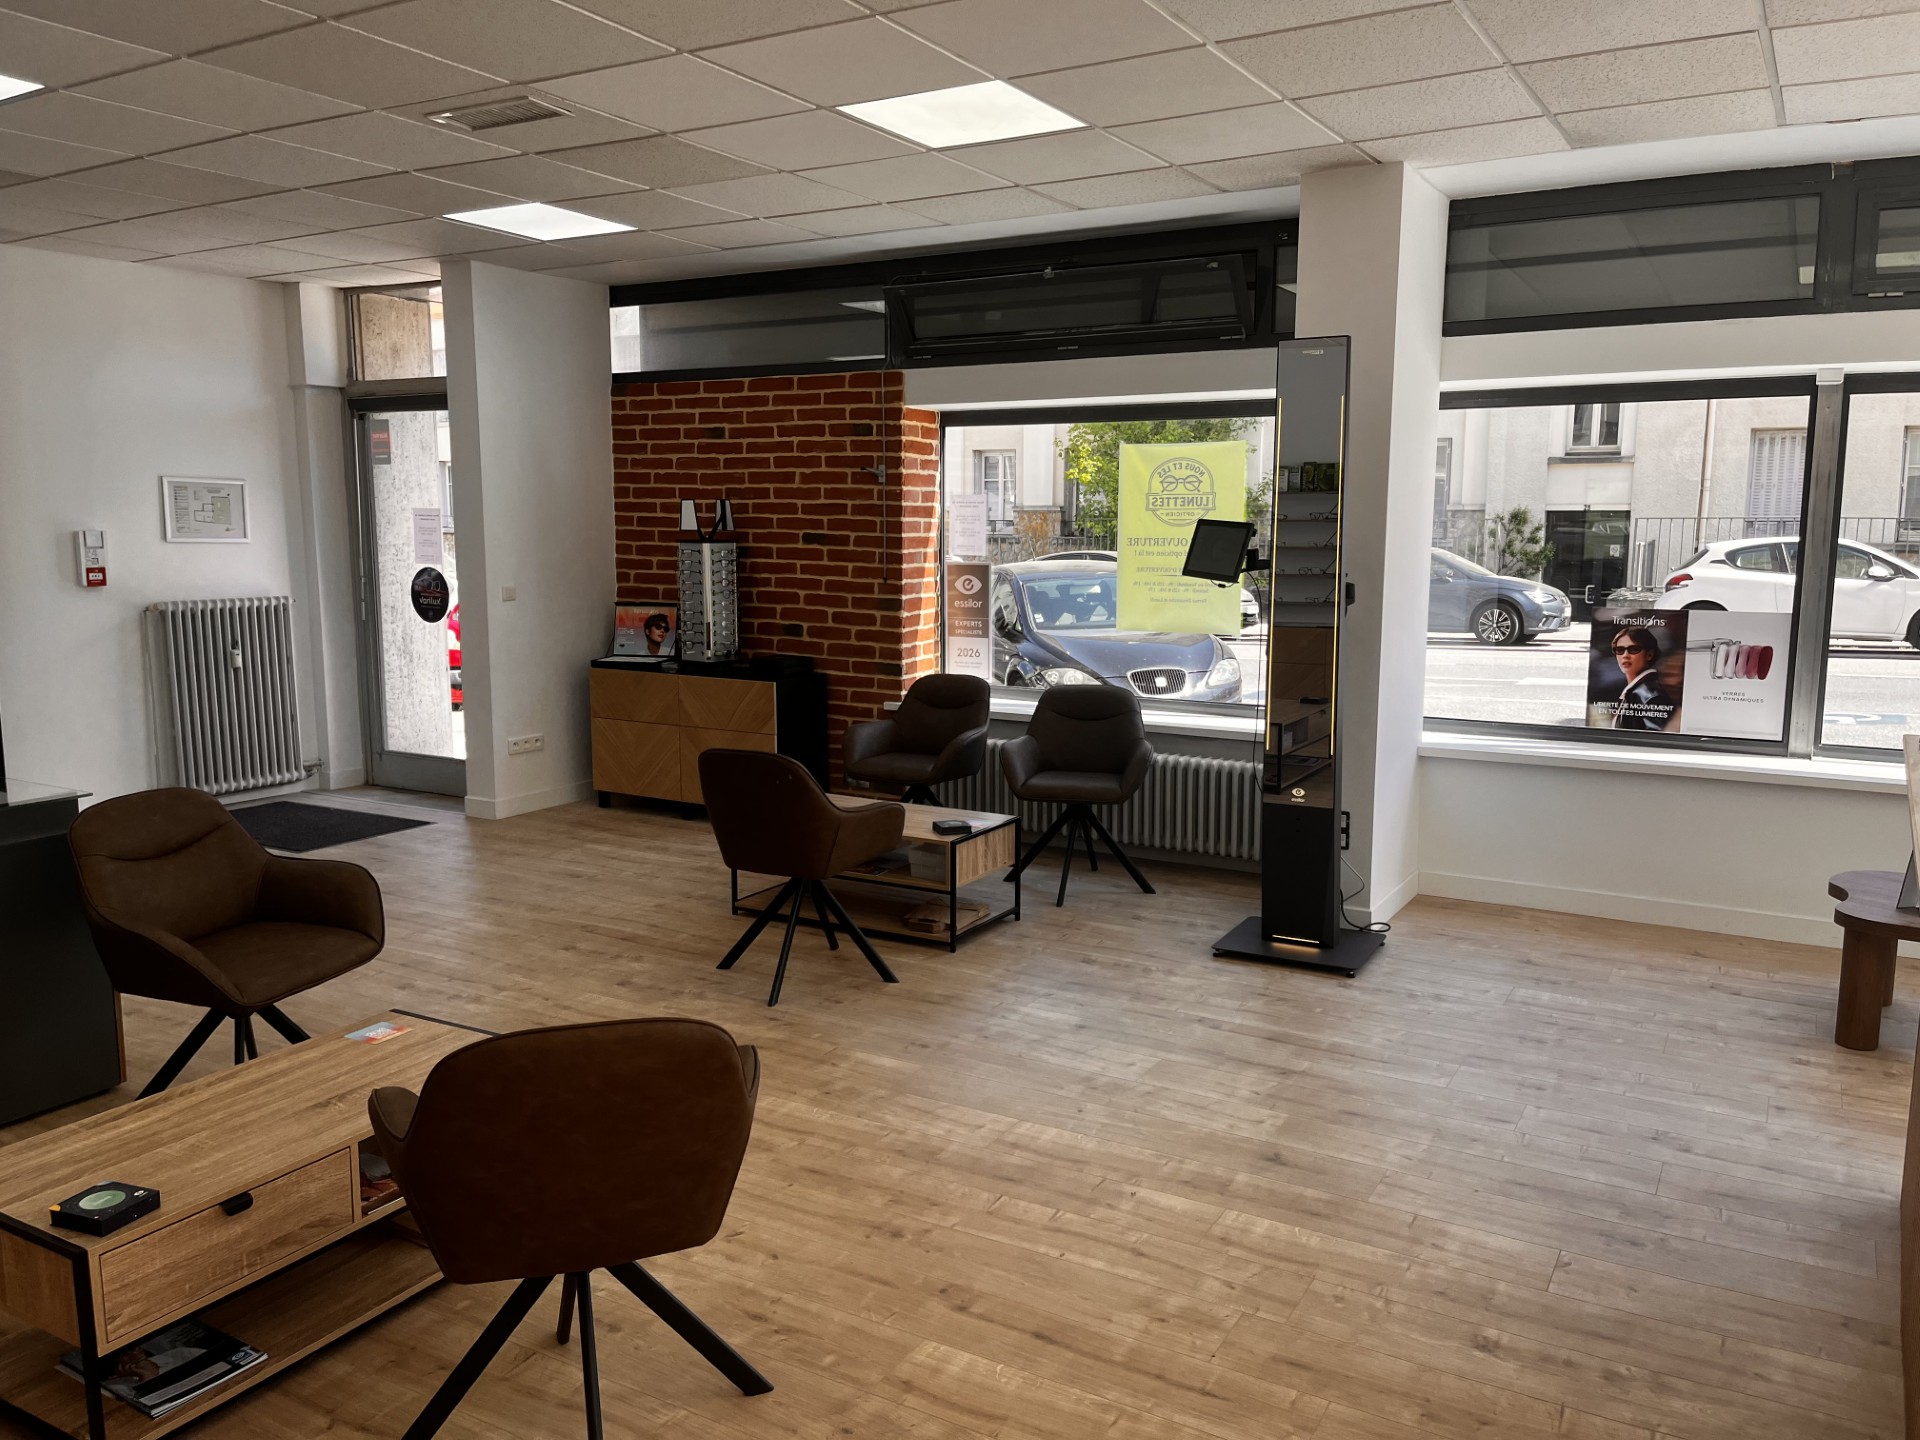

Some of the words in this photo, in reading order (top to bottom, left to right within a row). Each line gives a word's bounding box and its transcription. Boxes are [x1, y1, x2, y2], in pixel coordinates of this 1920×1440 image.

[954, 598, 983, 608] essilor
[955, 620, 983, 628] EXPERTS
[1612, 615, 1666, 629] Transitions
[957, 647, 981, 658] 2026
[1629, 703, 1674, 711] MOUVEMENT
